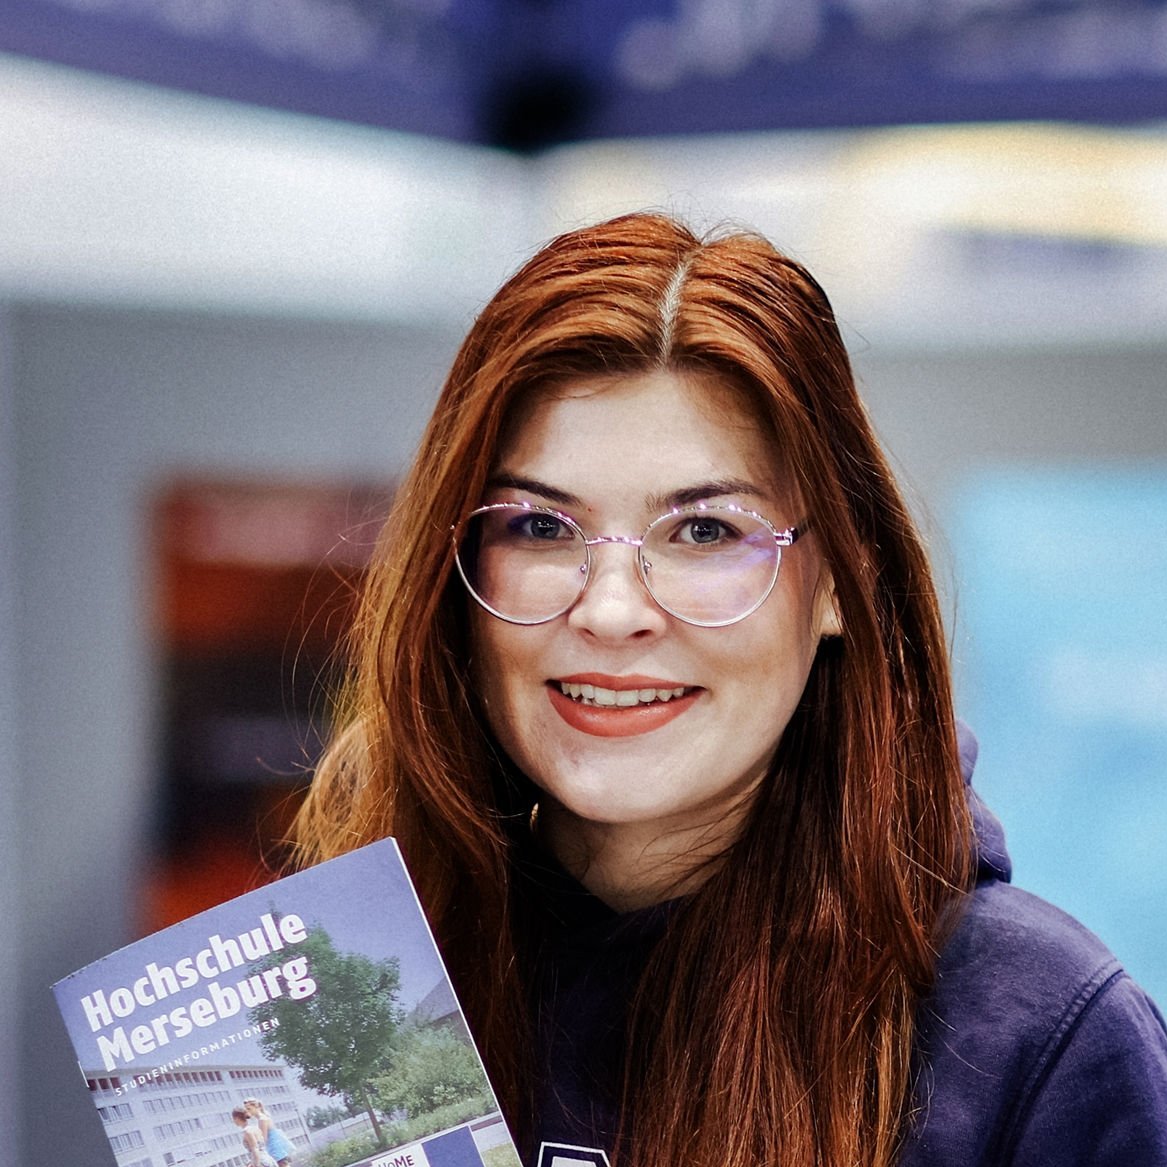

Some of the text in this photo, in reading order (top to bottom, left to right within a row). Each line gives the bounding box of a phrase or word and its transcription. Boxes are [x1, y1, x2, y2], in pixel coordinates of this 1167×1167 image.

[80, 912, 308, 1033] Hochschule
[96, 956, 317, 1073] Merseburg
[114, 1017, 281, 1097] STUDIENINFORMATIONEN
